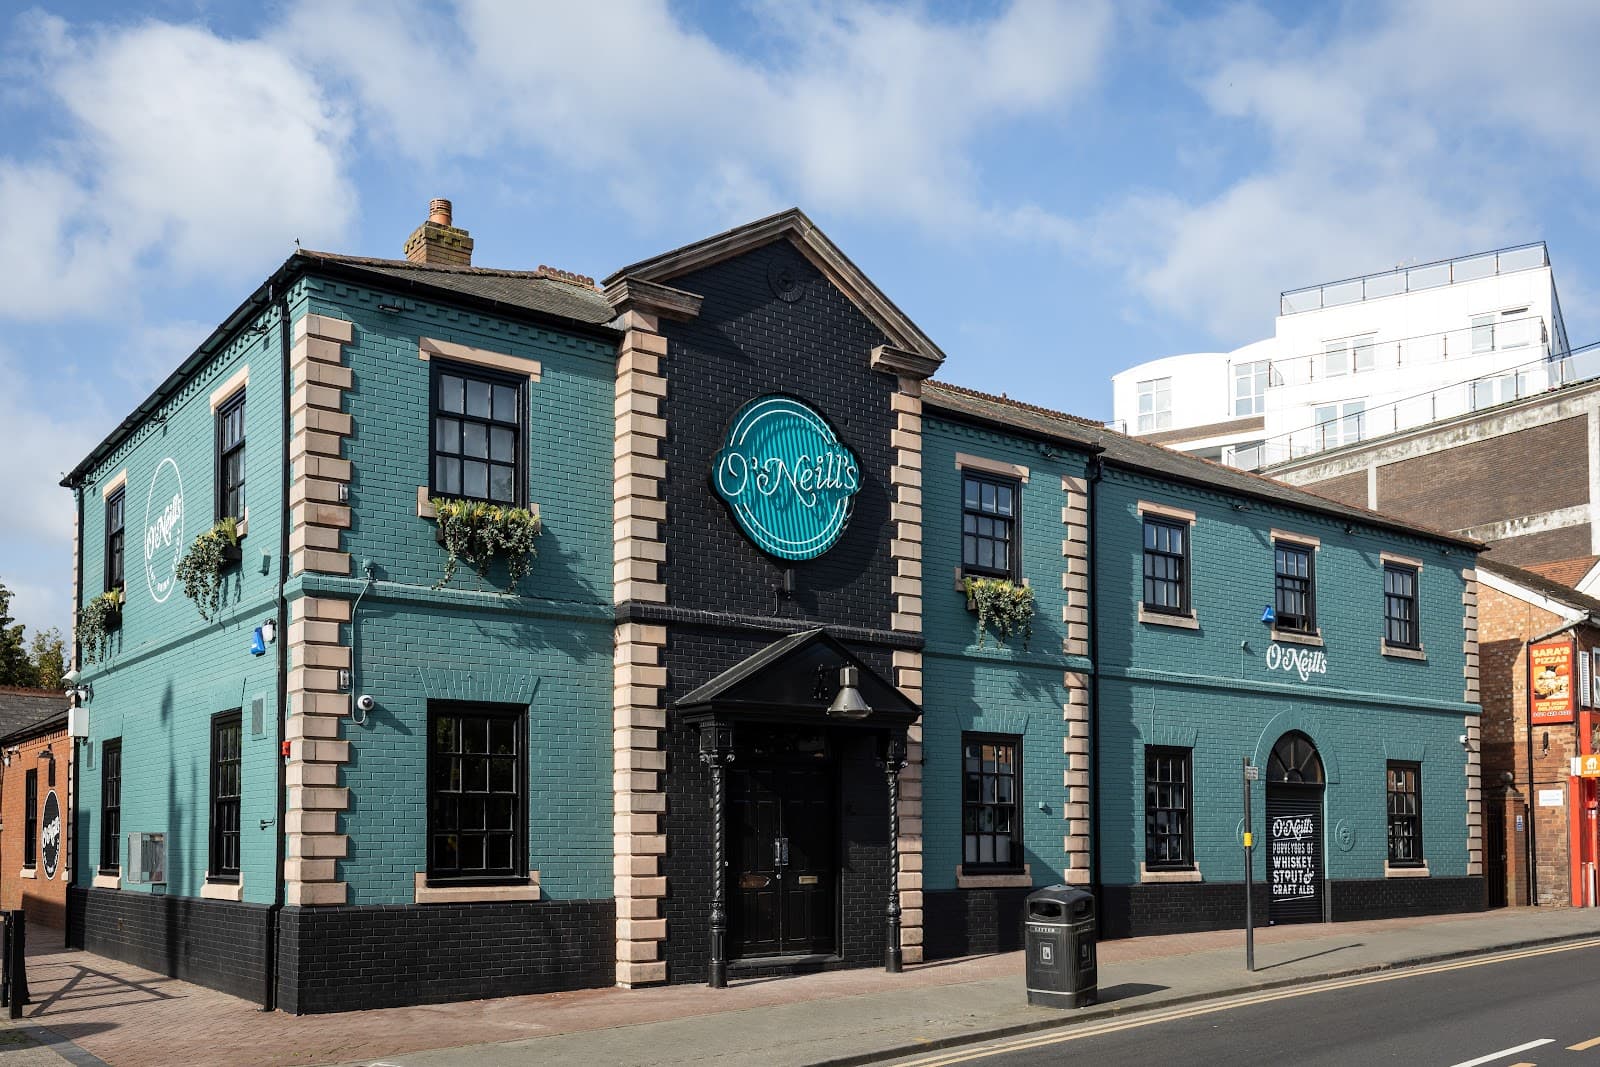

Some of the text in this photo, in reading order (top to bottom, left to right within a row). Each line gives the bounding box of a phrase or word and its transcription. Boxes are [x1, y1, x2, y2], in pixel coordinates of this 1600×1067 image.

[718, 451, 857, 508] O'Neill's
[146, 493, 182, 560] O'Neill's
[1532, 646, 1570, 657] SARA'S
[1534, 655, 1568, 665] PIZZAS
[1266, 643, 1327, 682] O'Neill's
[1272, 818, 1314, 840] O'Neill's
[1272, 842, 1314, 854] PURVEYORS OF
[1272, 884, 1315, 895] CRAFT ALES
